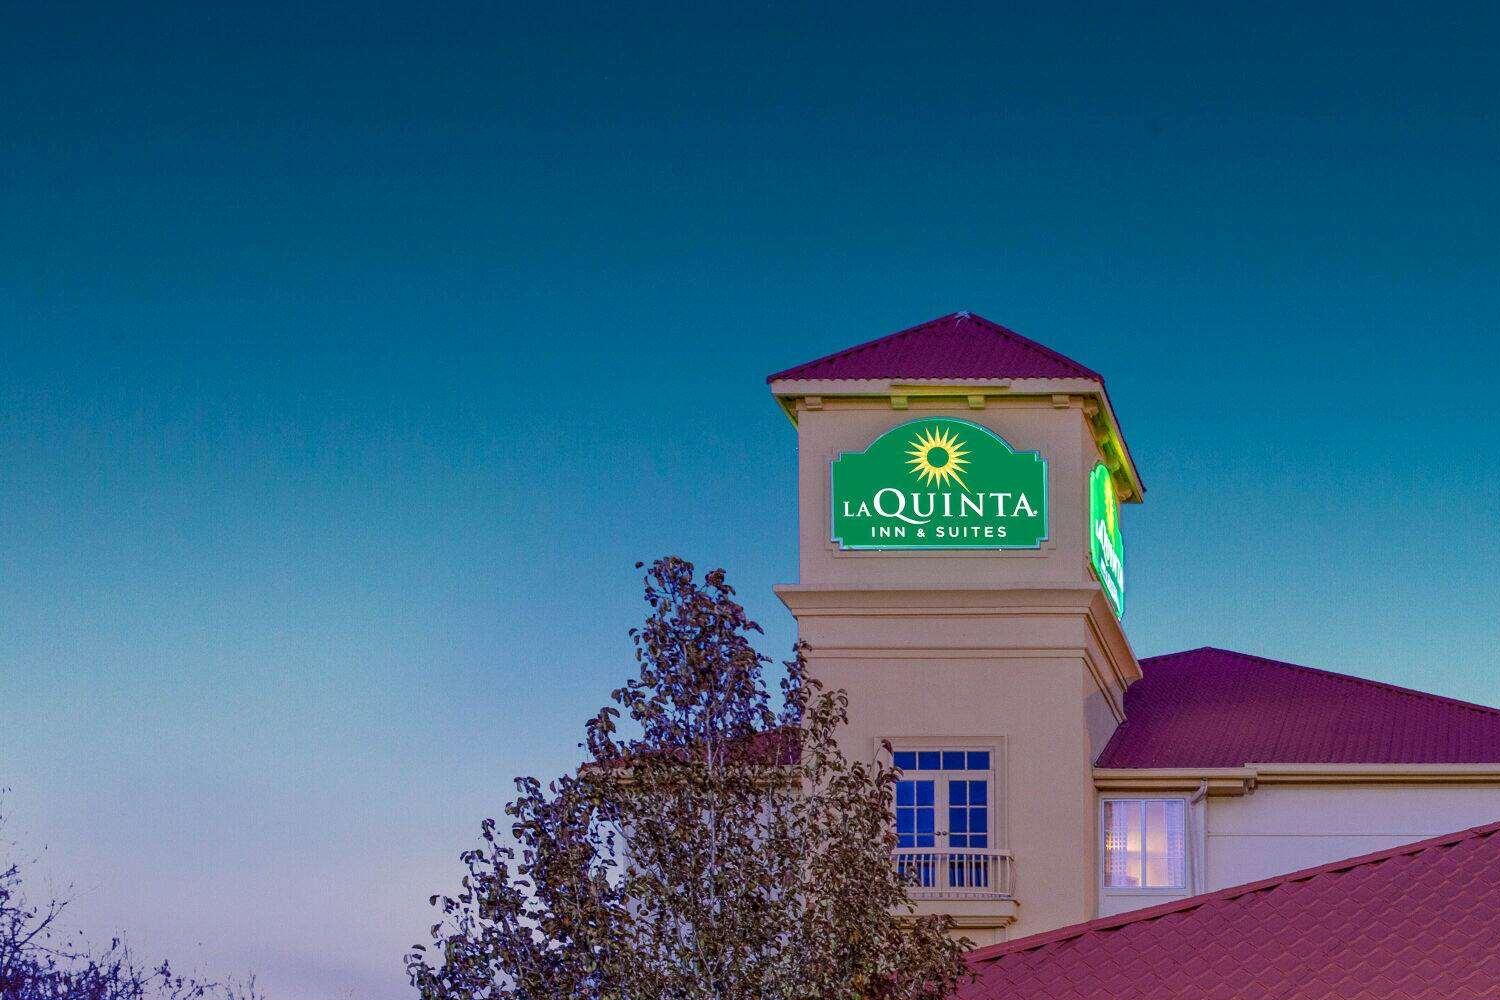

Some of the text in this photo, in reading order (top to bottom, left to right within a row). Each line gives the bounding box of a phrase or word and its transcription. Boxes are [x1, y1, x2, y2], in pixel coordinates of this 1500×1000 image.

[871, 526, 1008, 538] INN & SUITES
